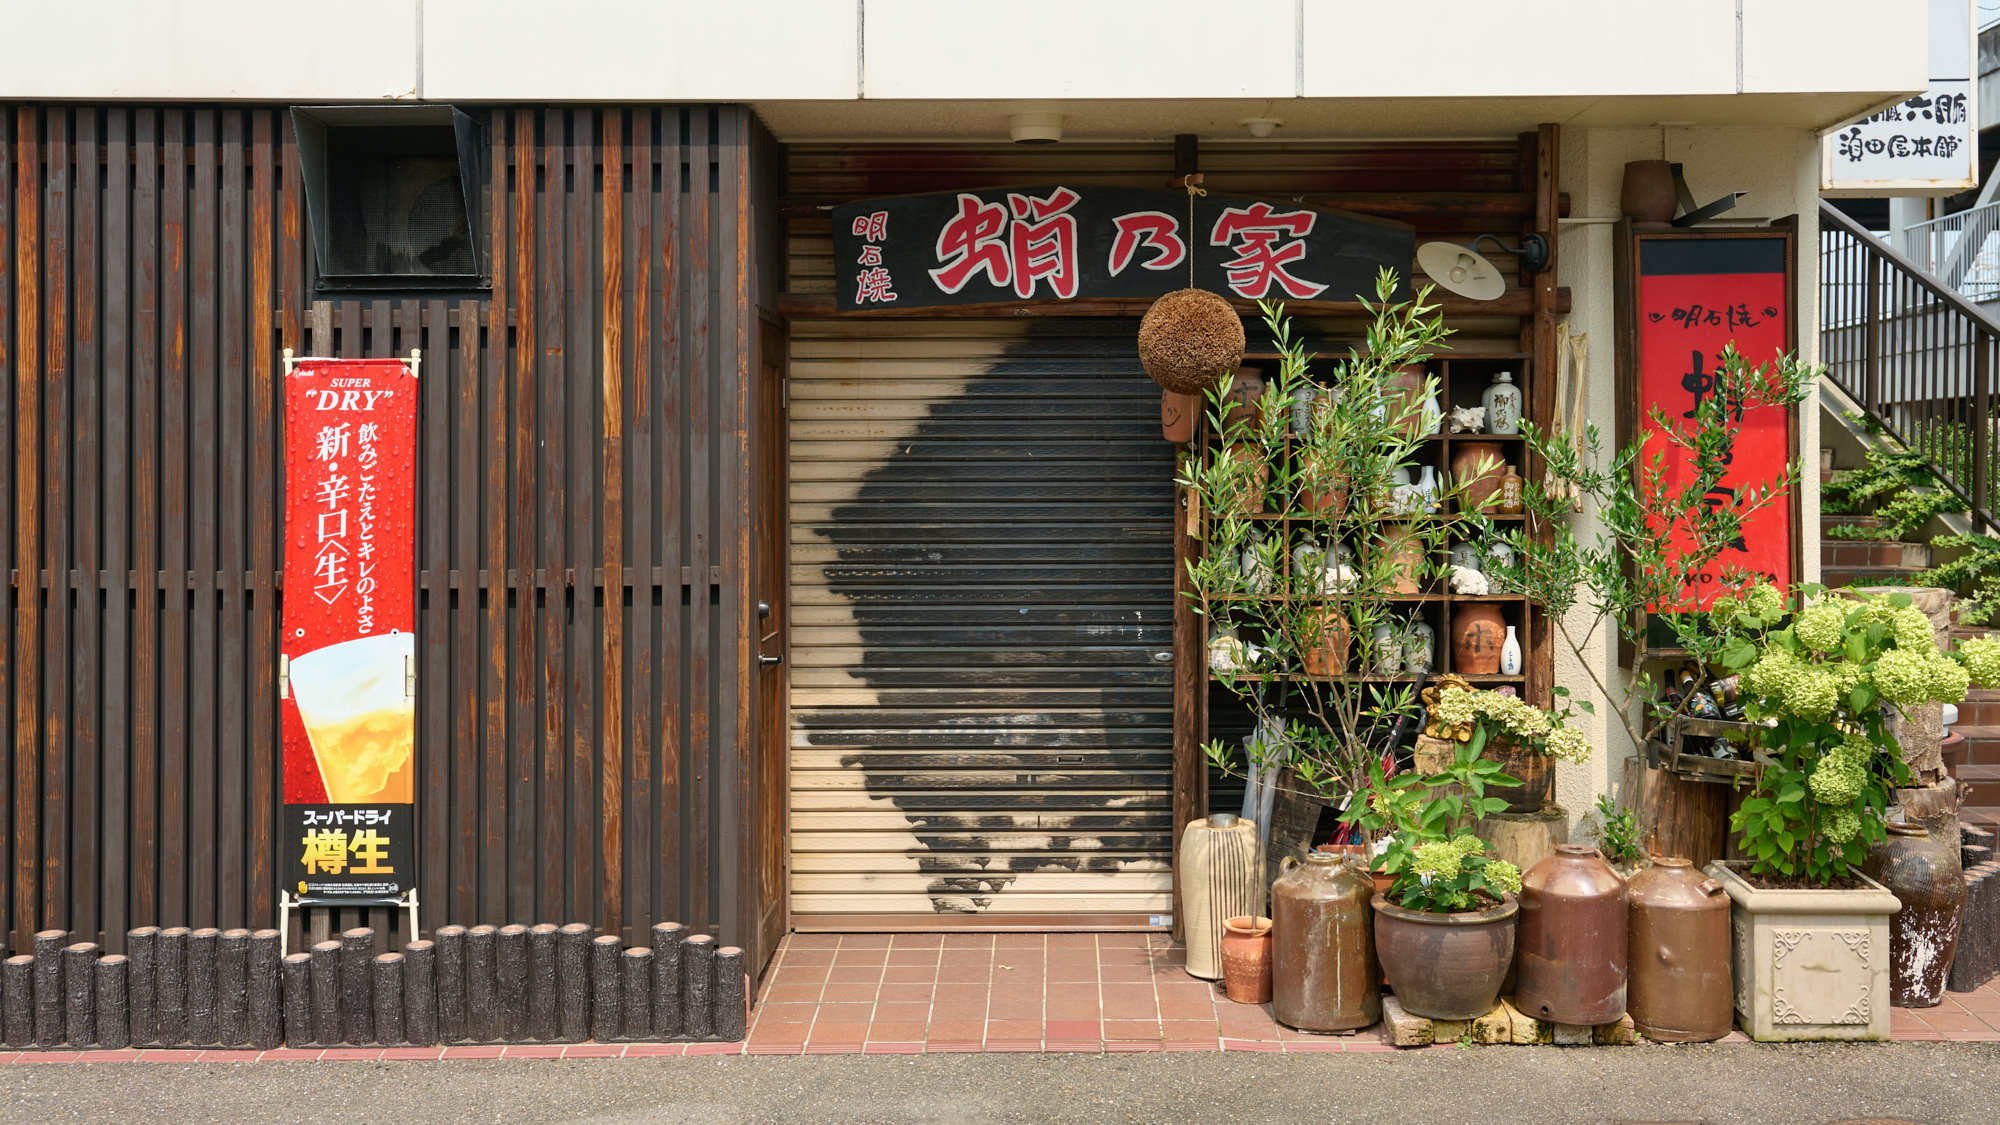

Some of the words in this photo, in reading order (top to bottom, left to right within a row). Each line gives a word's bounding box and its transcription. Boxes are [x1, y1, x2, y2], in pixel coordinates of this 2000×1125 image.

[852, 210, 898, 305] 明石焼
[1672, 302, 1761, 332] 明石焼
[330, 377, 371, 388] SUPER
[357, 422, 379, 635] 飲みごたえとキレのよさ
[303, 809, 392, 825] スーパードライ
[300, 828, 394, 875] 樽生
